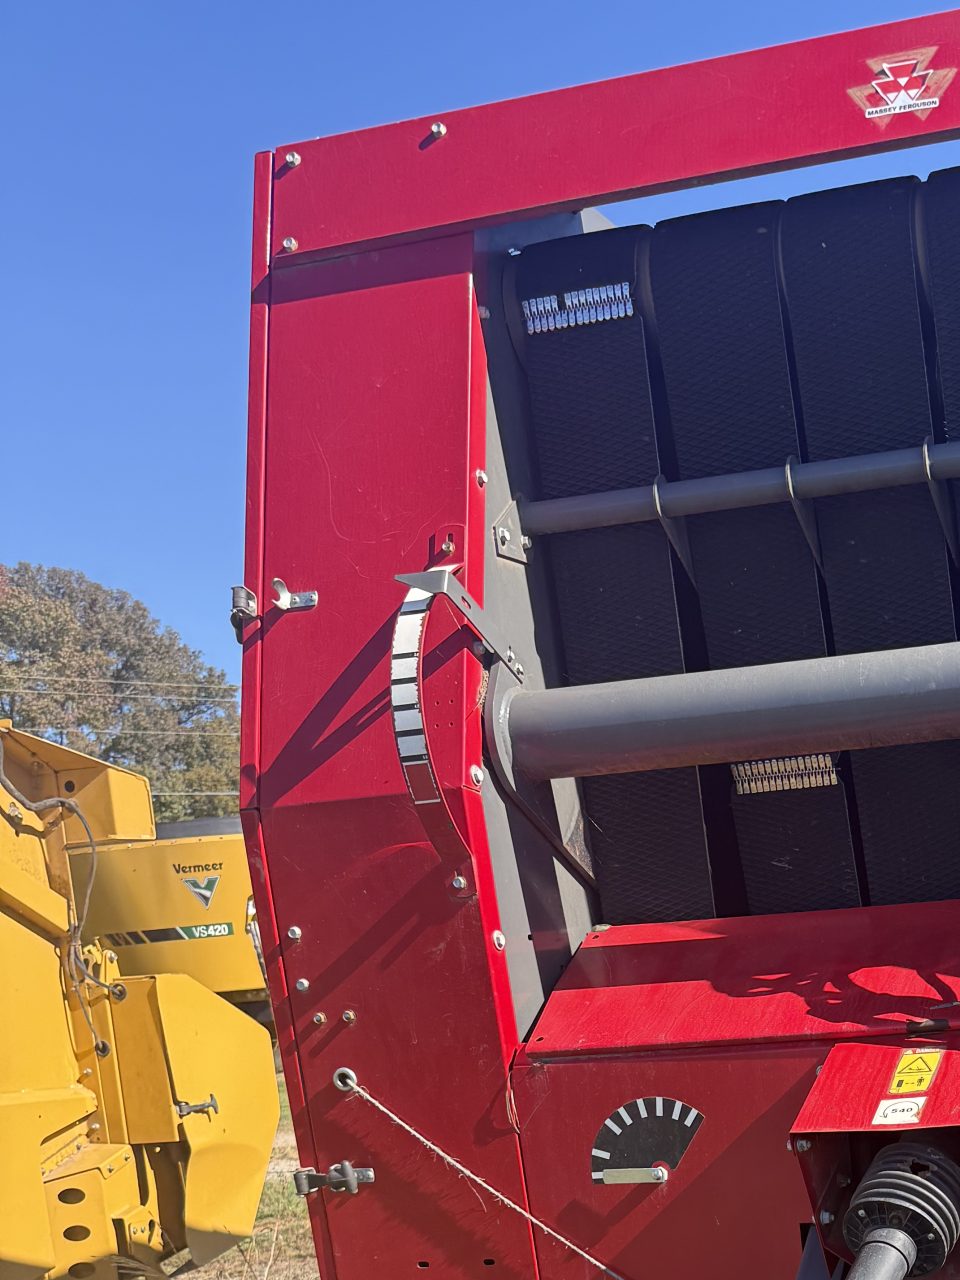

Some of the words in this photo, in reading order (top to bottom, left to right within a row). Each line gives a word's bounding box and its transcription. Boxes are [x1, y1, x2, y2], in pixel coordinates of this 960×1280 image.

[868, 107, 897, 116] MASSEY
[899, 100, 937, 110] FERGUSON
[173, 862, 223, 874] Vermeer
[192, 924, 229, 938] VS420
